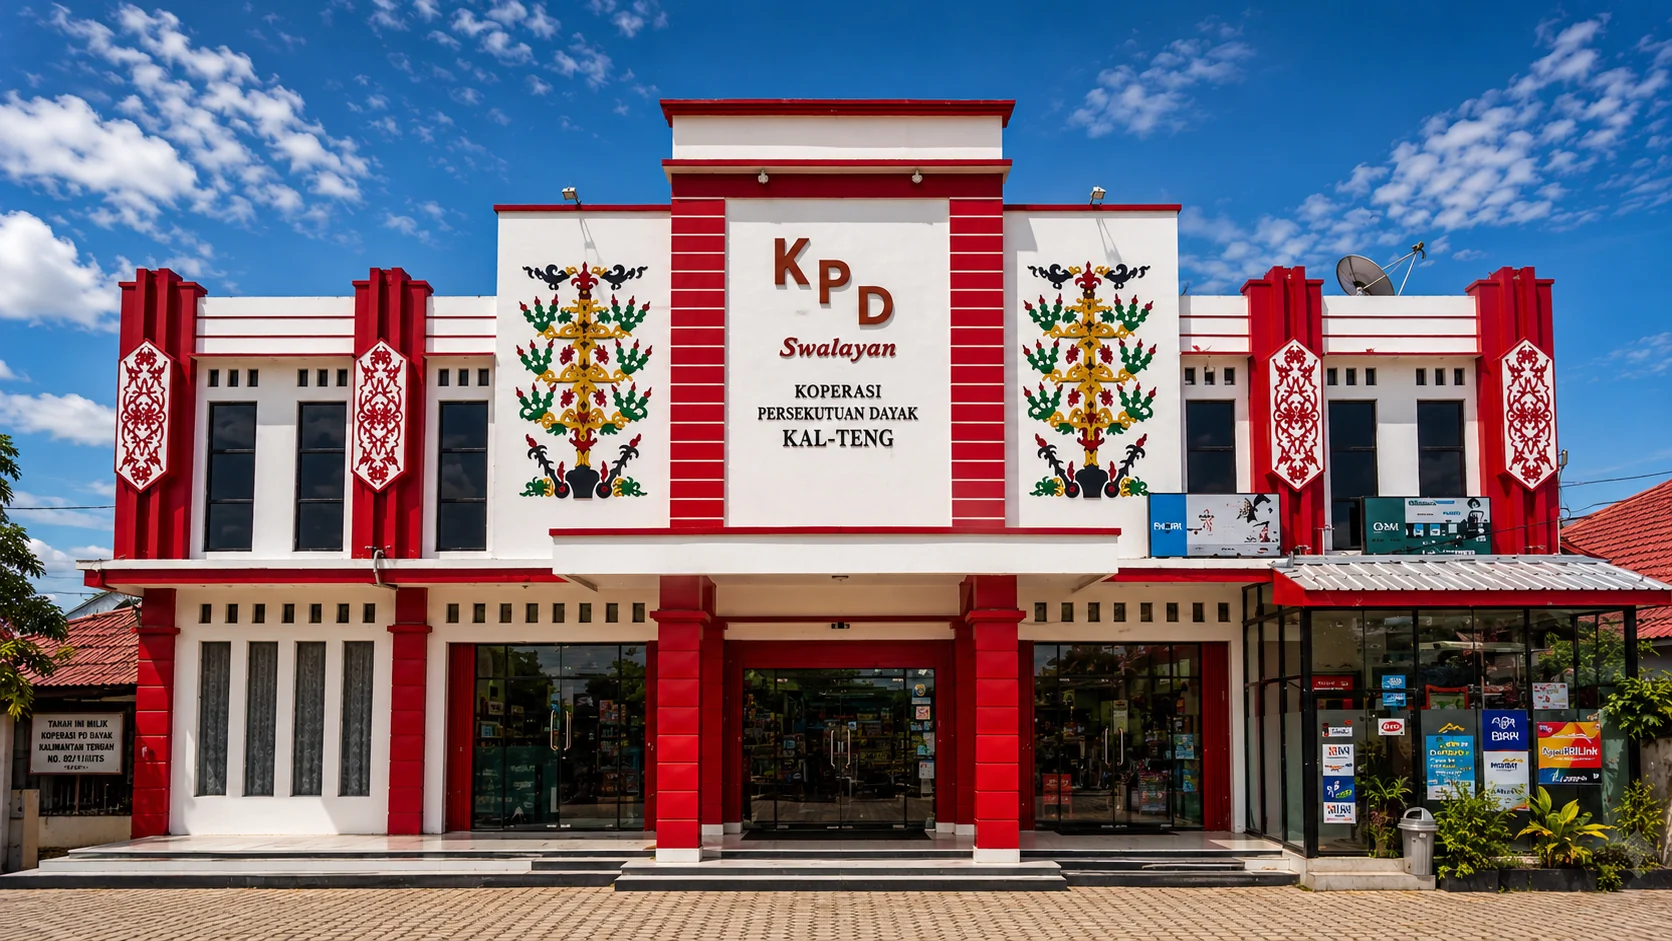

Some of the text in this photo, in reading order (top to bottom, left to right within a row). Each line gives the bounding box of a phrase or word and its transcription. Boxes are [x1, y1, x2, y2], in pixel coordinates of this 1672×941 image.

[774, 237, 894, 325] KPD
[779, 337, 896, 363] Swalayan
[795, 384, 881, 398] KOPERASI
[758, 407, 918, 420] PERSEKUTUAN DAYAK
[783, 429, 894, 447] KAL-TENG
[41, 731, 76, 740] KOPERASI
[47, 755, 61, 763] NO.
